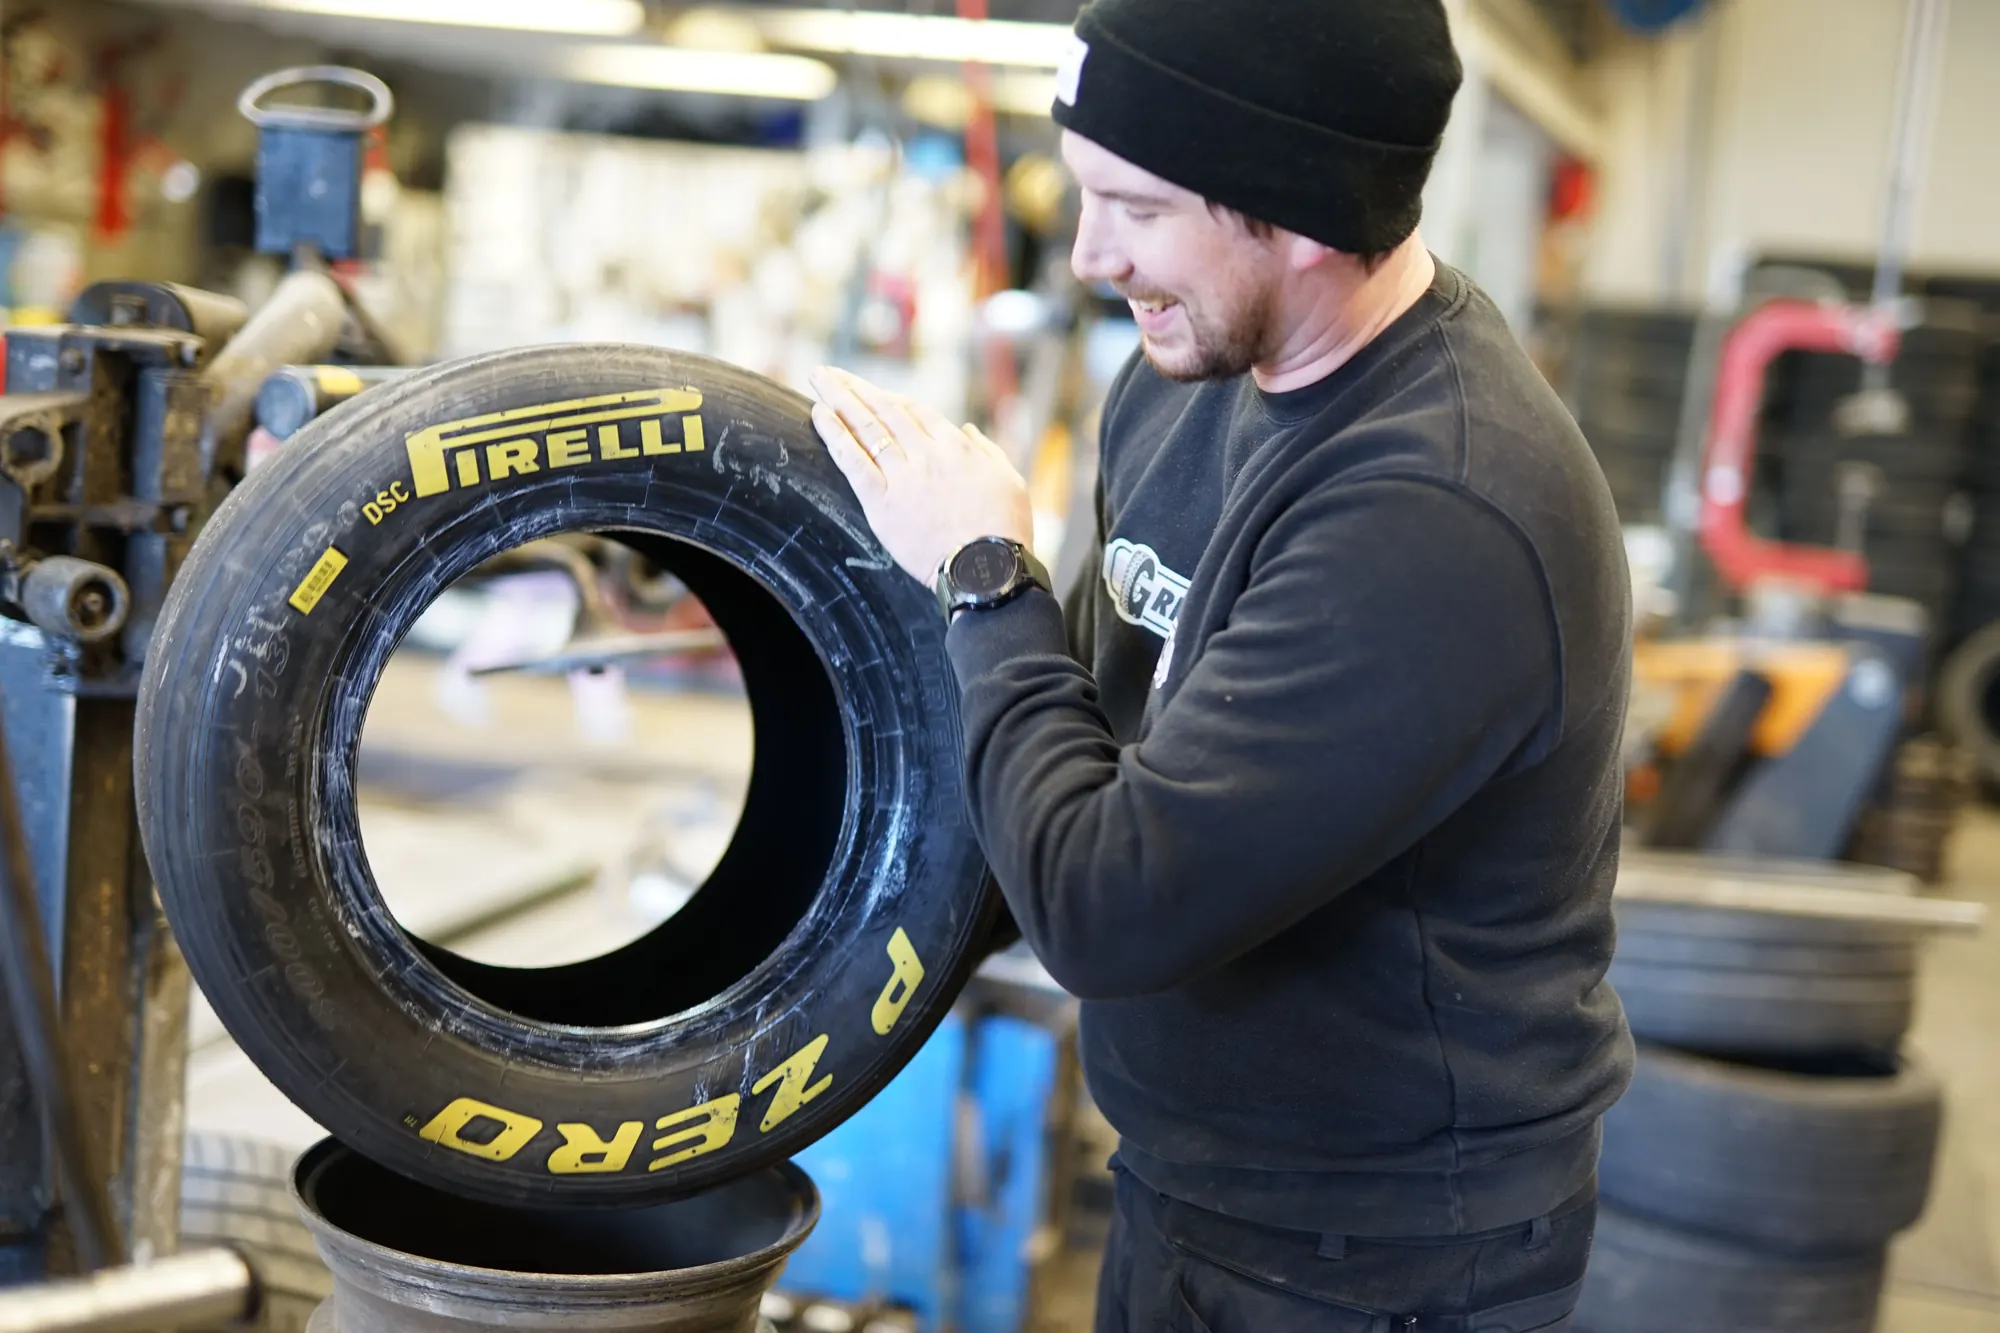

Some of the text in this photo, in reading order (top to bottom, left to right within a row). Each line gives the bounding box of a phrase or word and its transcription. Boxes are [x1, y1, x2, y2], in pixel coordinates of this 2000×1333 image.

[404, 386, 704, 498] PIRELLI
[362, 480, 409, 526] DSC
[871, 926, 925, 1036] P
[419, 1033, 833, 1174] ZERO
